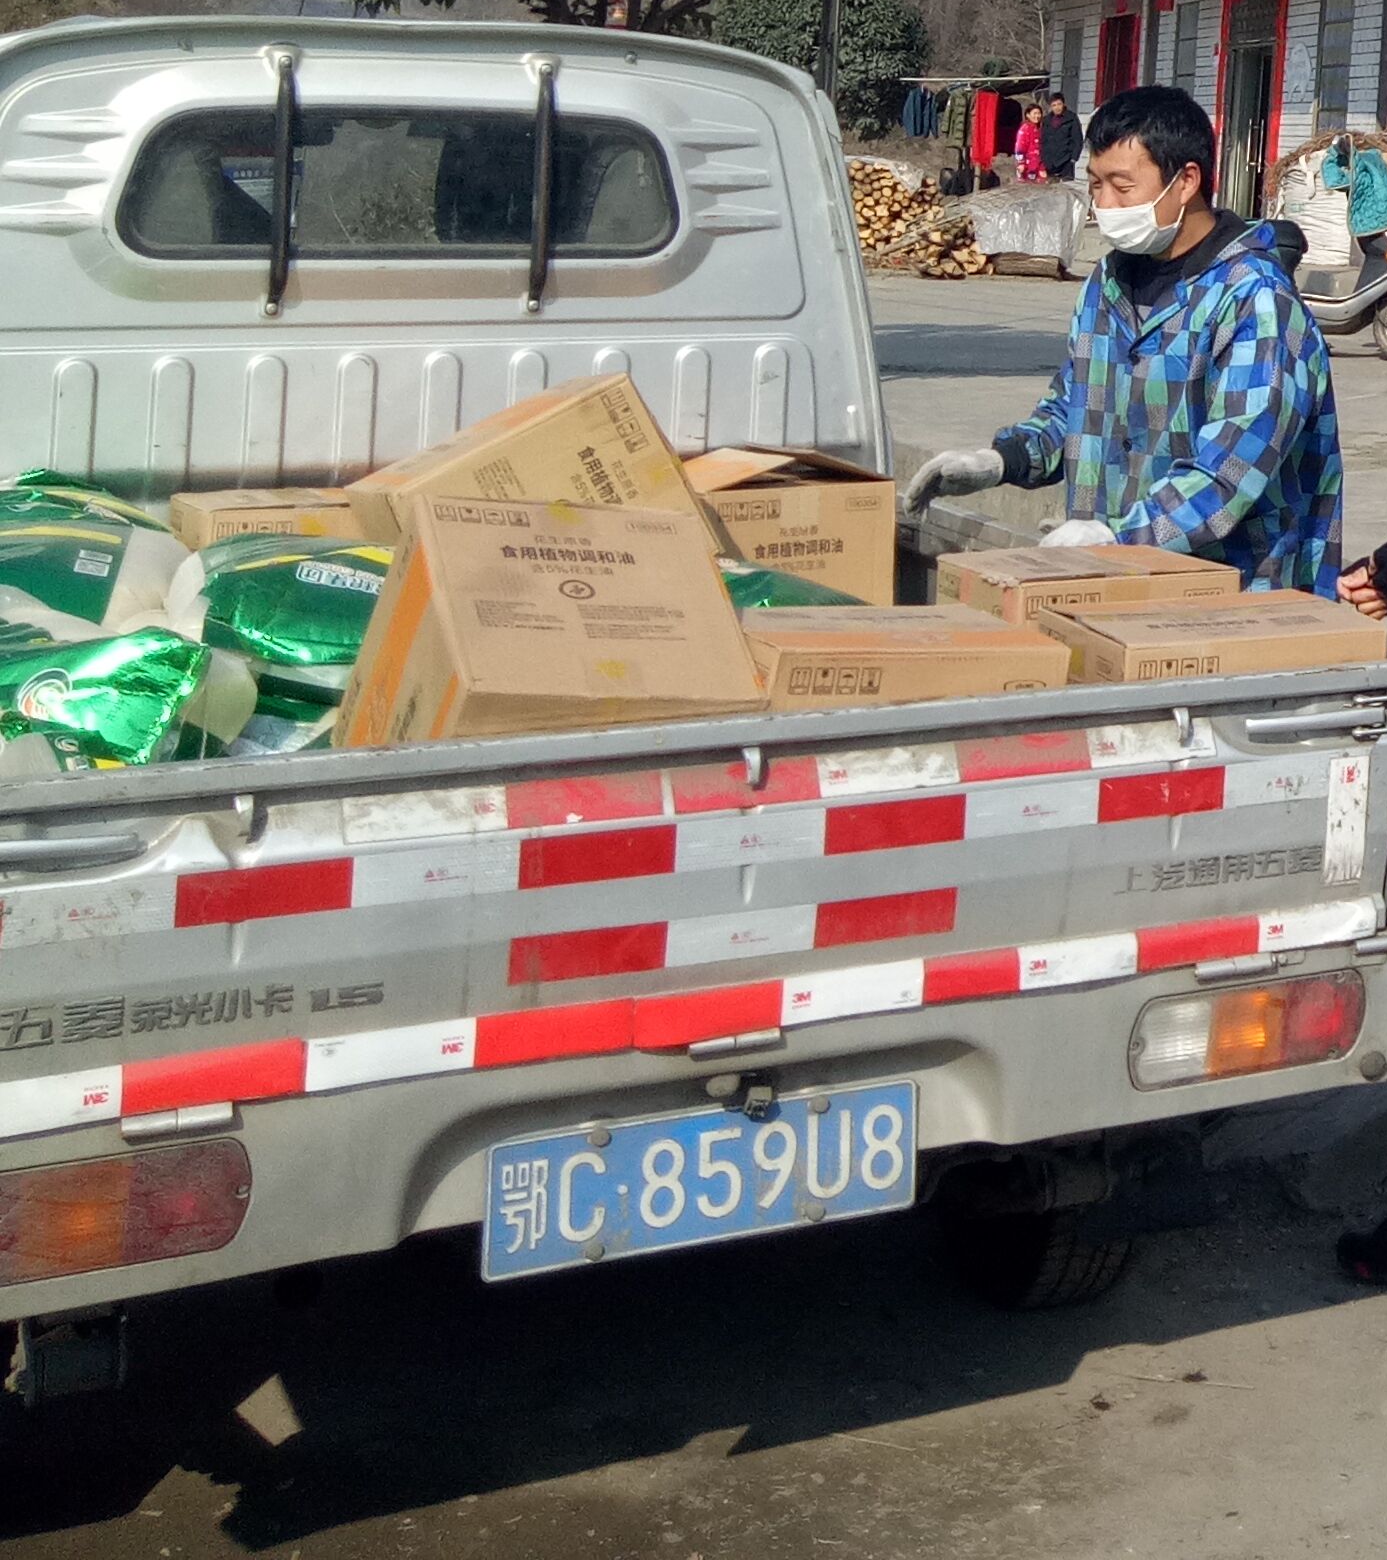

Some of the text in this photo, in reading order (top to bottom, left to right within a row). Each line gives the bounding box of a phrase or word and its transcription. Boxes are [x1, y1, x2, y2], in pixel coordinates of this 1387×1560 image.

[499, 544, 636, 566] 食用植物调和油
[1113, 845, 1324, 895] 上汽通用五菱
[1266, 924, 1285, 937] 3M
[1029, 959, 1048, 972] 3M
[791, 990, 813, 1004] 3M
[498, 1102, 908, 1254] 鄂C·859U8
